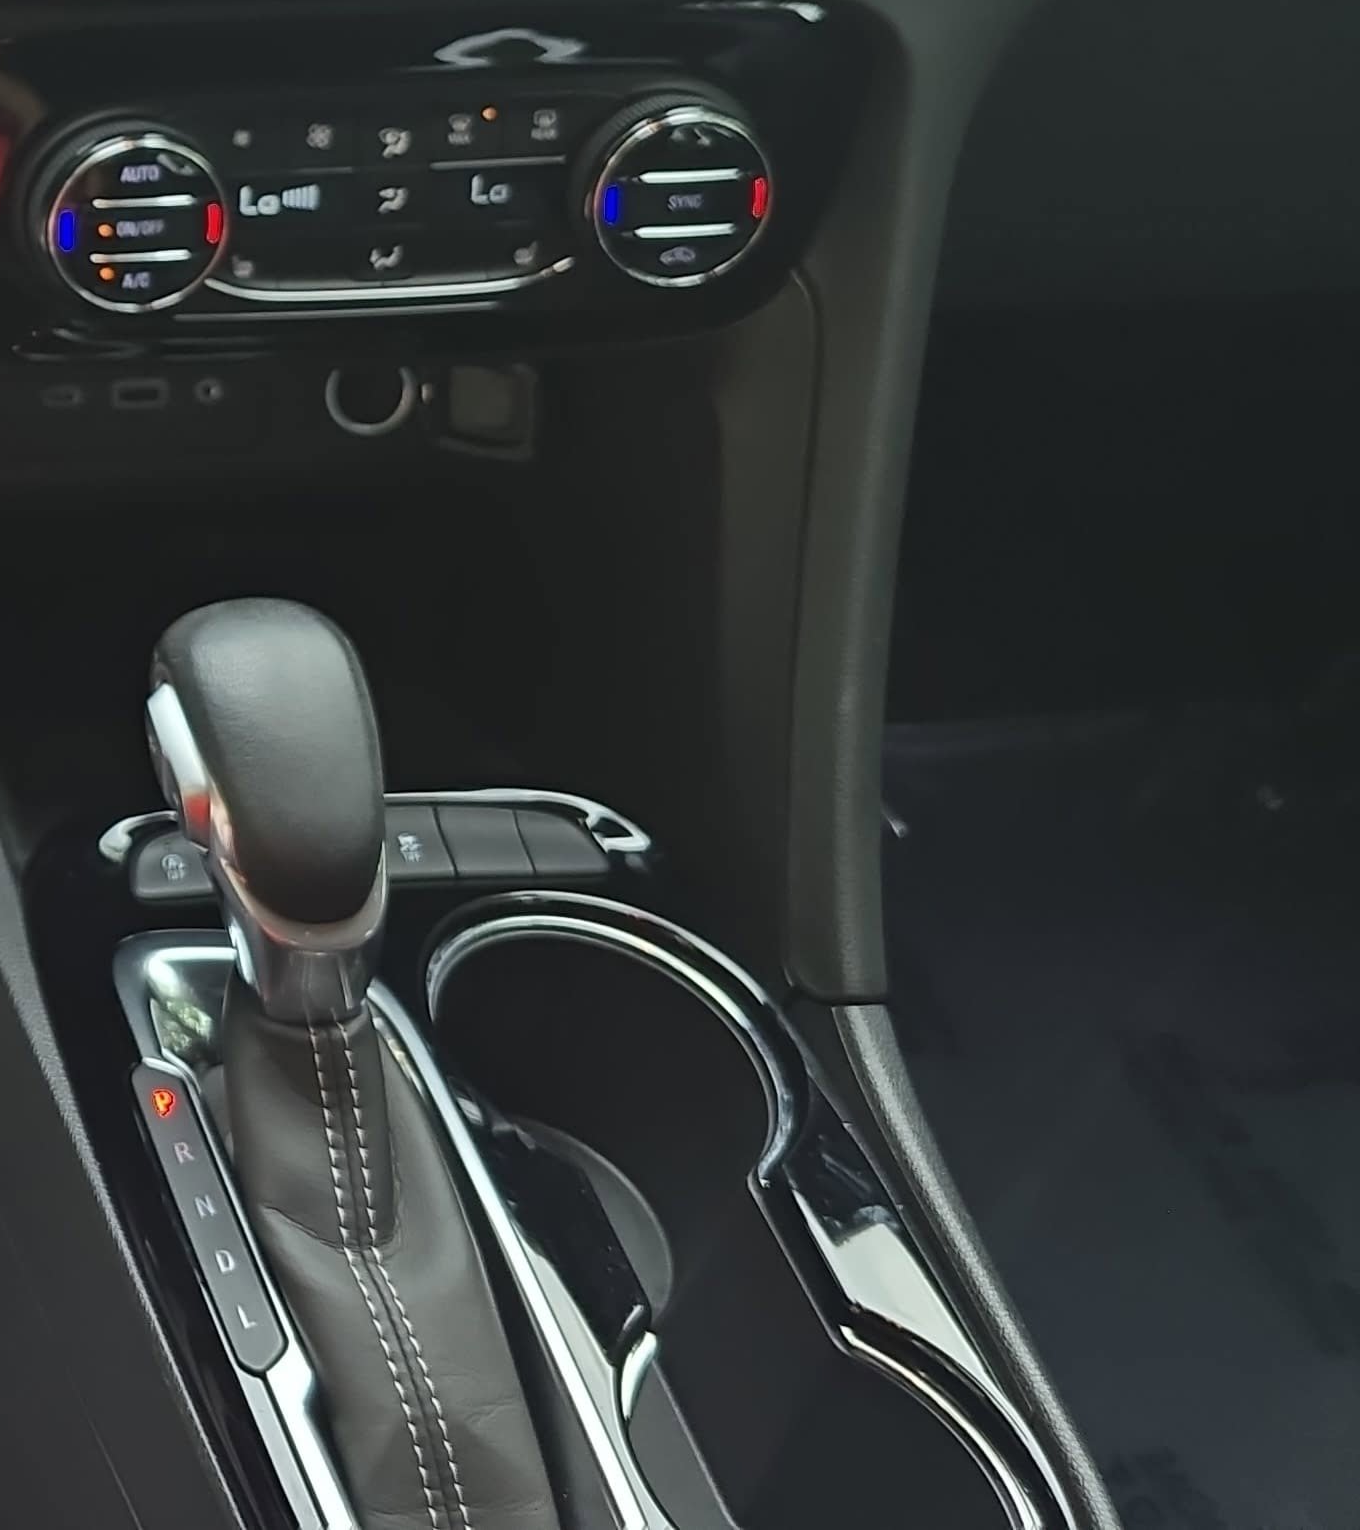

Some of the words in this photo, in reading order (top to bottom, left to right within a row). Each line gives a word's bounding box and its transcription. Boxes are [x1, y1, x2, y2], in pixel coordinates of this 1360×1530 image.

[120, 165, 162, 183] AUTO
[122, 272, 152, 288] A/C
[152, 1089, 175, 1117] P
[174, 1142, 194, 1163] R
[194, 1195, 218, 1219] N
[215, 1250, 236, 1273] D
[237, 1304, 257, 1329] L
